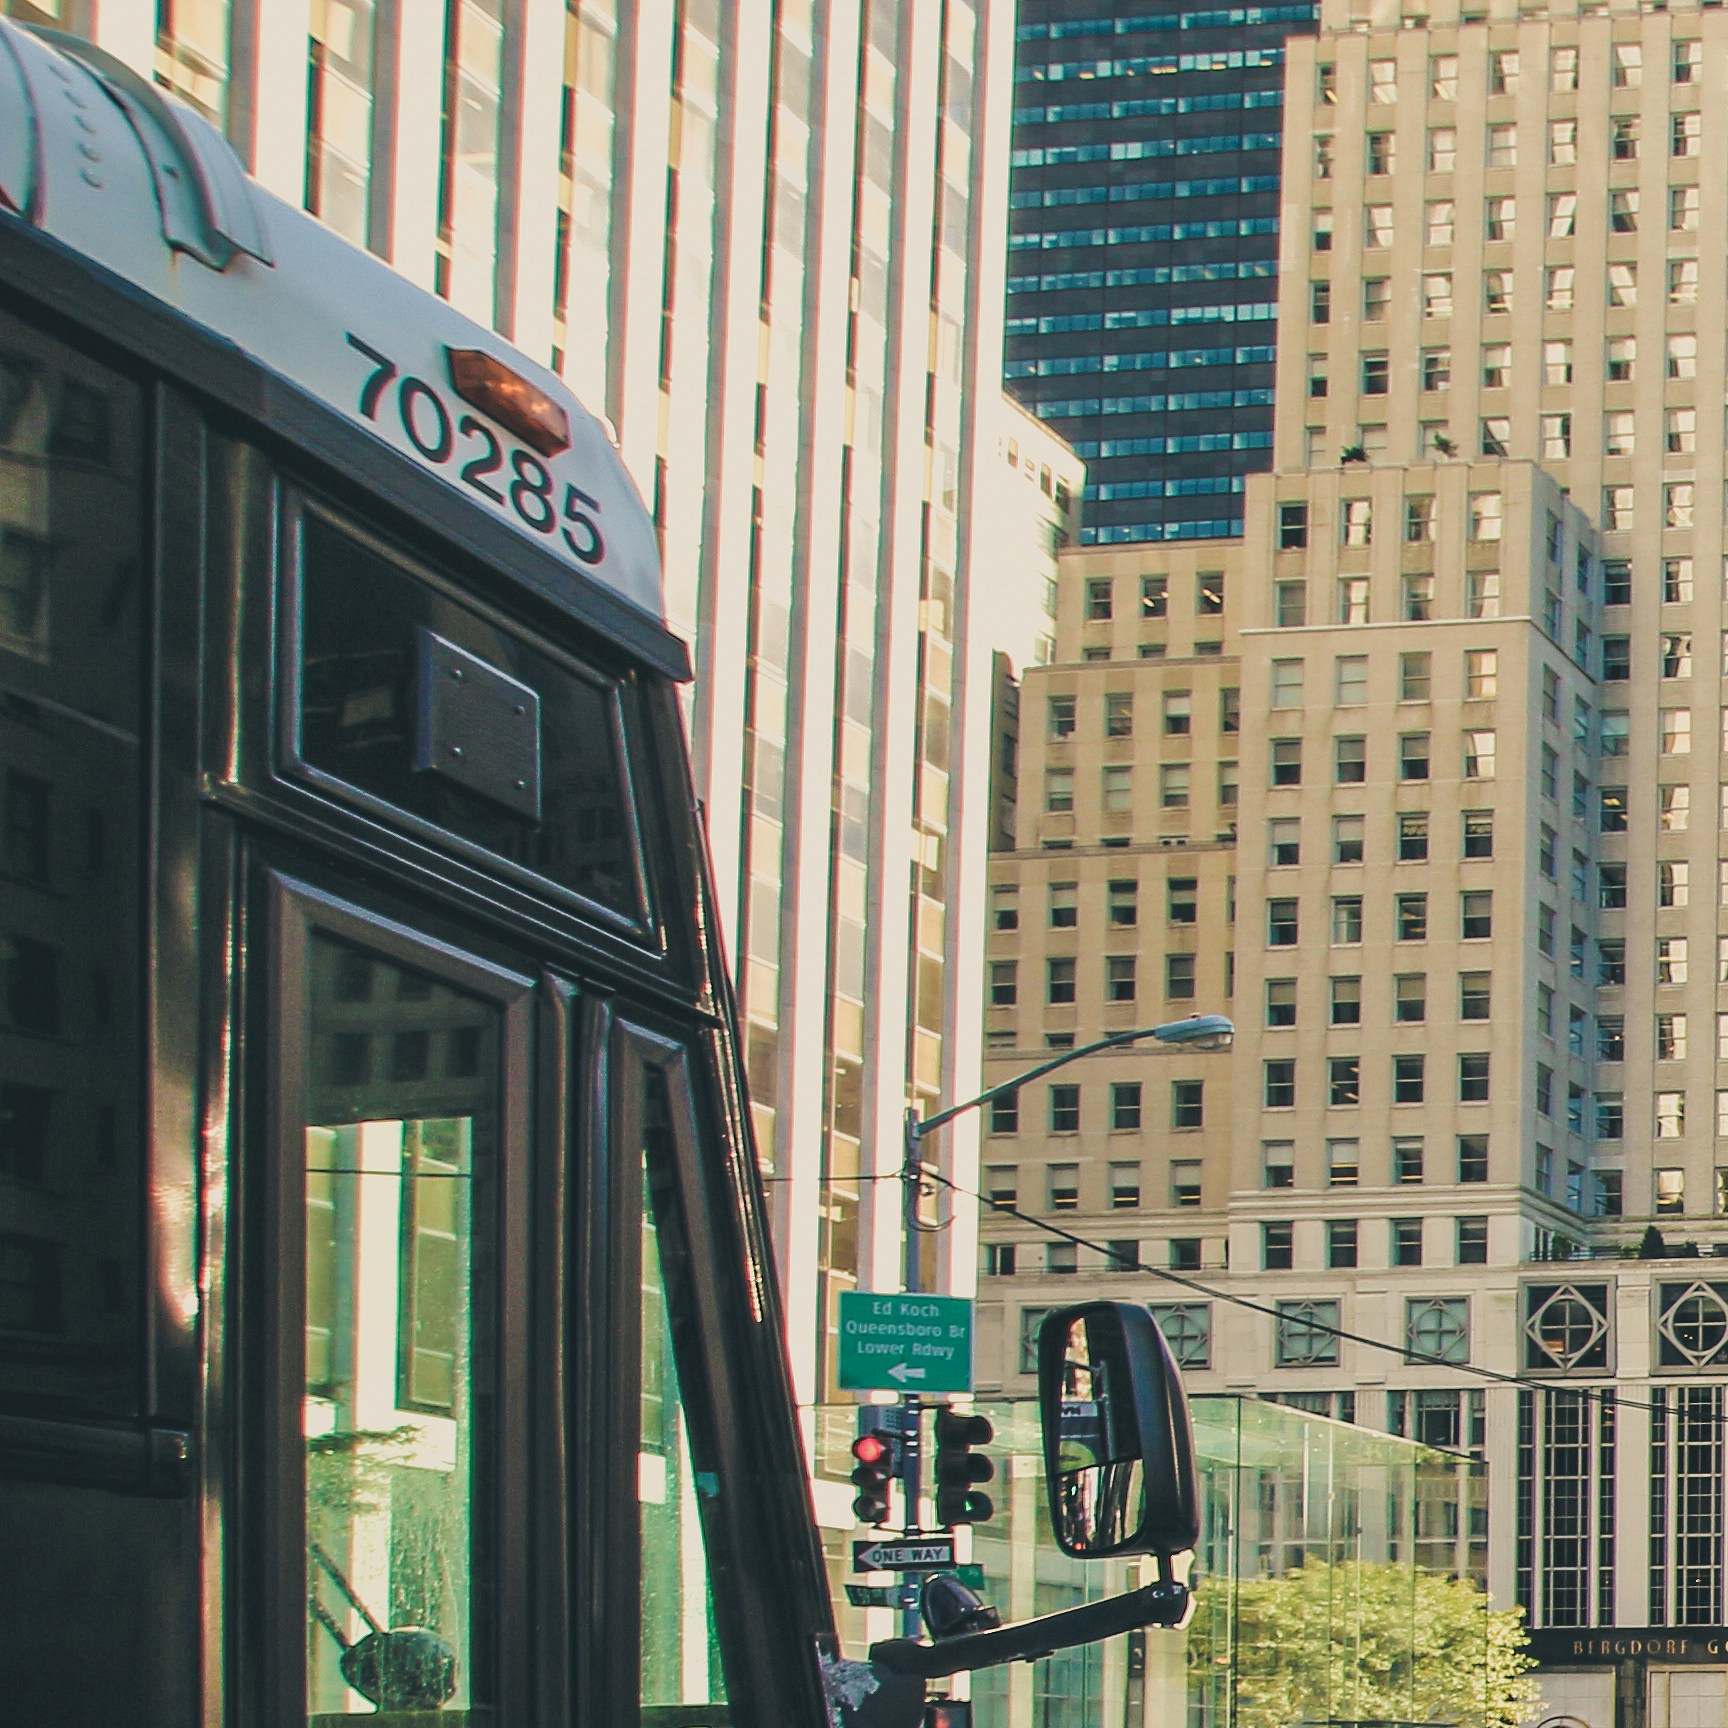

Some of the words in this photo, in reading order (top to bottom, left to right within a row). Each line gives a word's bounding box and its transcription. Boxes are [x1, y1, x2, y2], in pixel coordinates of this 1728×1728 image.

[346, 331, 606, 565] 70285
[872, 1302, 892, 1315] Ed
[901, 1303, 939, 1317] Koch
[846, 1320, 942, 1337] Queensboro
[949, 1325, 965, 1338] Br
[857, 1341, 905, 1354] Lower
[912, 1343, 954, 1360] Rdwy
[872, 1549, 904, 1563] ONE
[912, 1547, 943, 1561] WAY
[1573, 1639, 1688, 1655] BERGDORF
